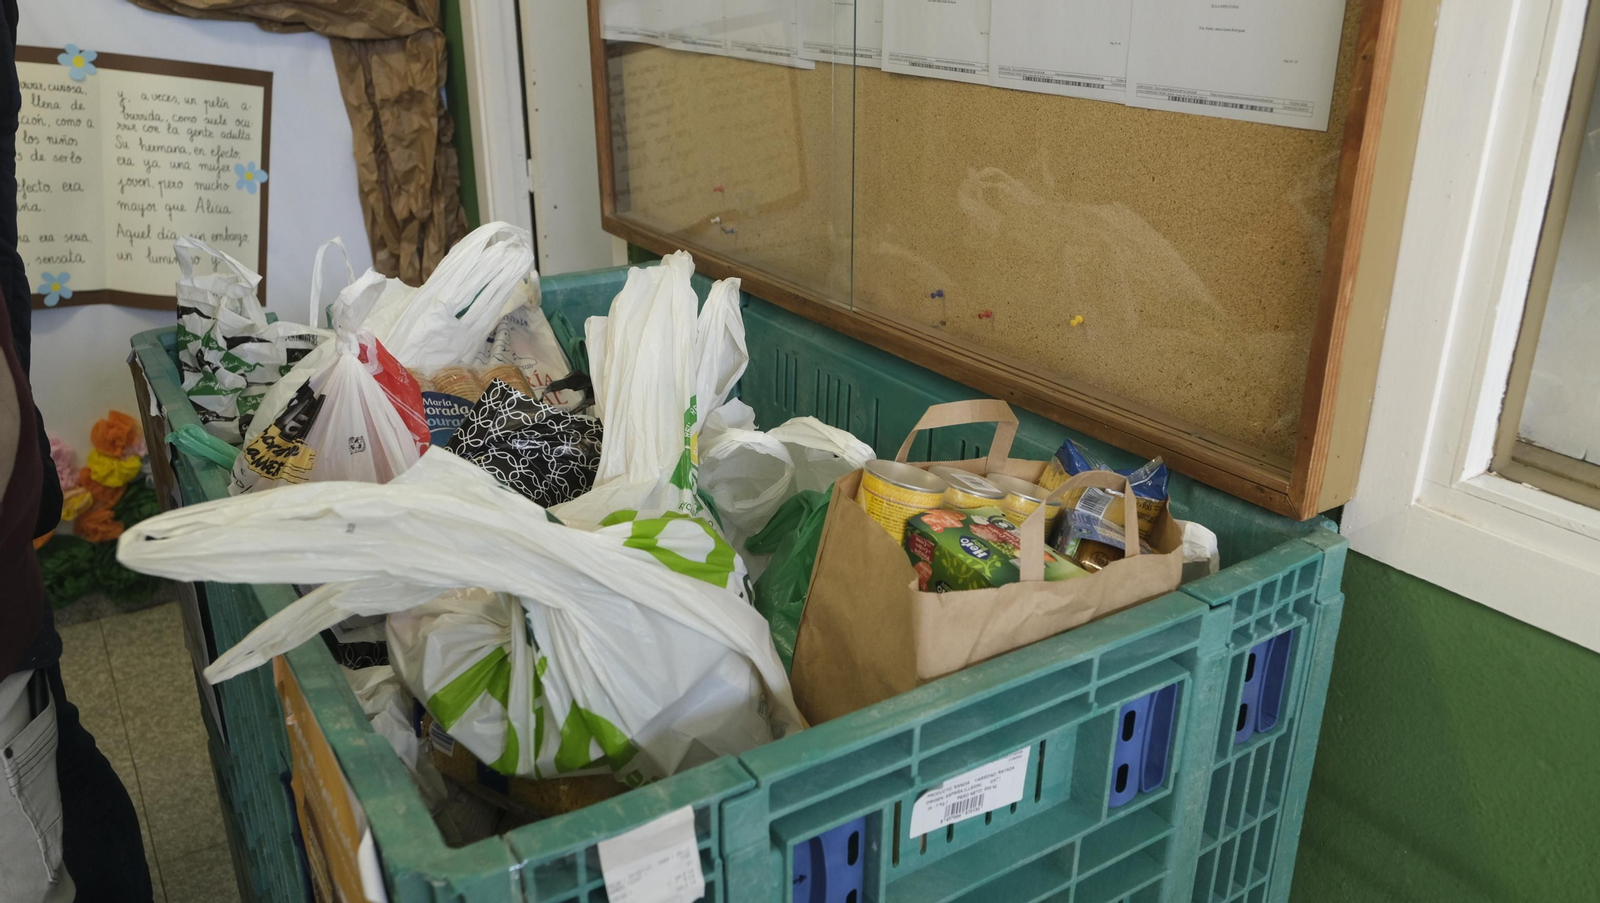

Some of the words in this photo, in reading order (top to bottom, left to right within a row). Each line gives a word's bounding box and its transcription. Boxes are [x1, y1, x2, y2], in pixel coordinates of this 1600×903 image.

[32, 93, 61, 110] llena
[71, 99, 85, 111] de
[141, 92, 149, 101] a
[150, 92, 180, 105] veces,
[184, 96, 197, 106] un
[56, 118, 81, 127] como
[86, 118, 94, 129] a
[172, 114, 197, 124] como
[204, 114, 229, 127] suele
[23, 130, 39, 145] los
[47, 135, 78, 146] niños
[142, 124, 161, 134] con
[166, 122, 180, 135] la
[186, 126, 215, 143] gente
[115, 134, 130, 150] Su
[139, 137, 192, 156] hermana,
[193, 146, 207, 156] en
[30, 148, 46, 162] de
[116, 155, 135, 167] era
[143, 158, 161, 174] ya
[170, 161, 191, 171] una
[199, 162, 232, 179] mujer
[62, 182, 84, 192] era
[158, 179, 184, 199] pero
[194, 179, 231, 191] mucho
[117, 199, 158, 218] mayor
[165, 204, 187, 222] que
[39, 234, 55, 244] era
[116, 222, 151, 247] Aquel
[35, 249, 85, 265] sensata
[116, 252, 134, 261] un
[424, 404, 470, 416] orada
[959, 537, 988, 559] Hero
